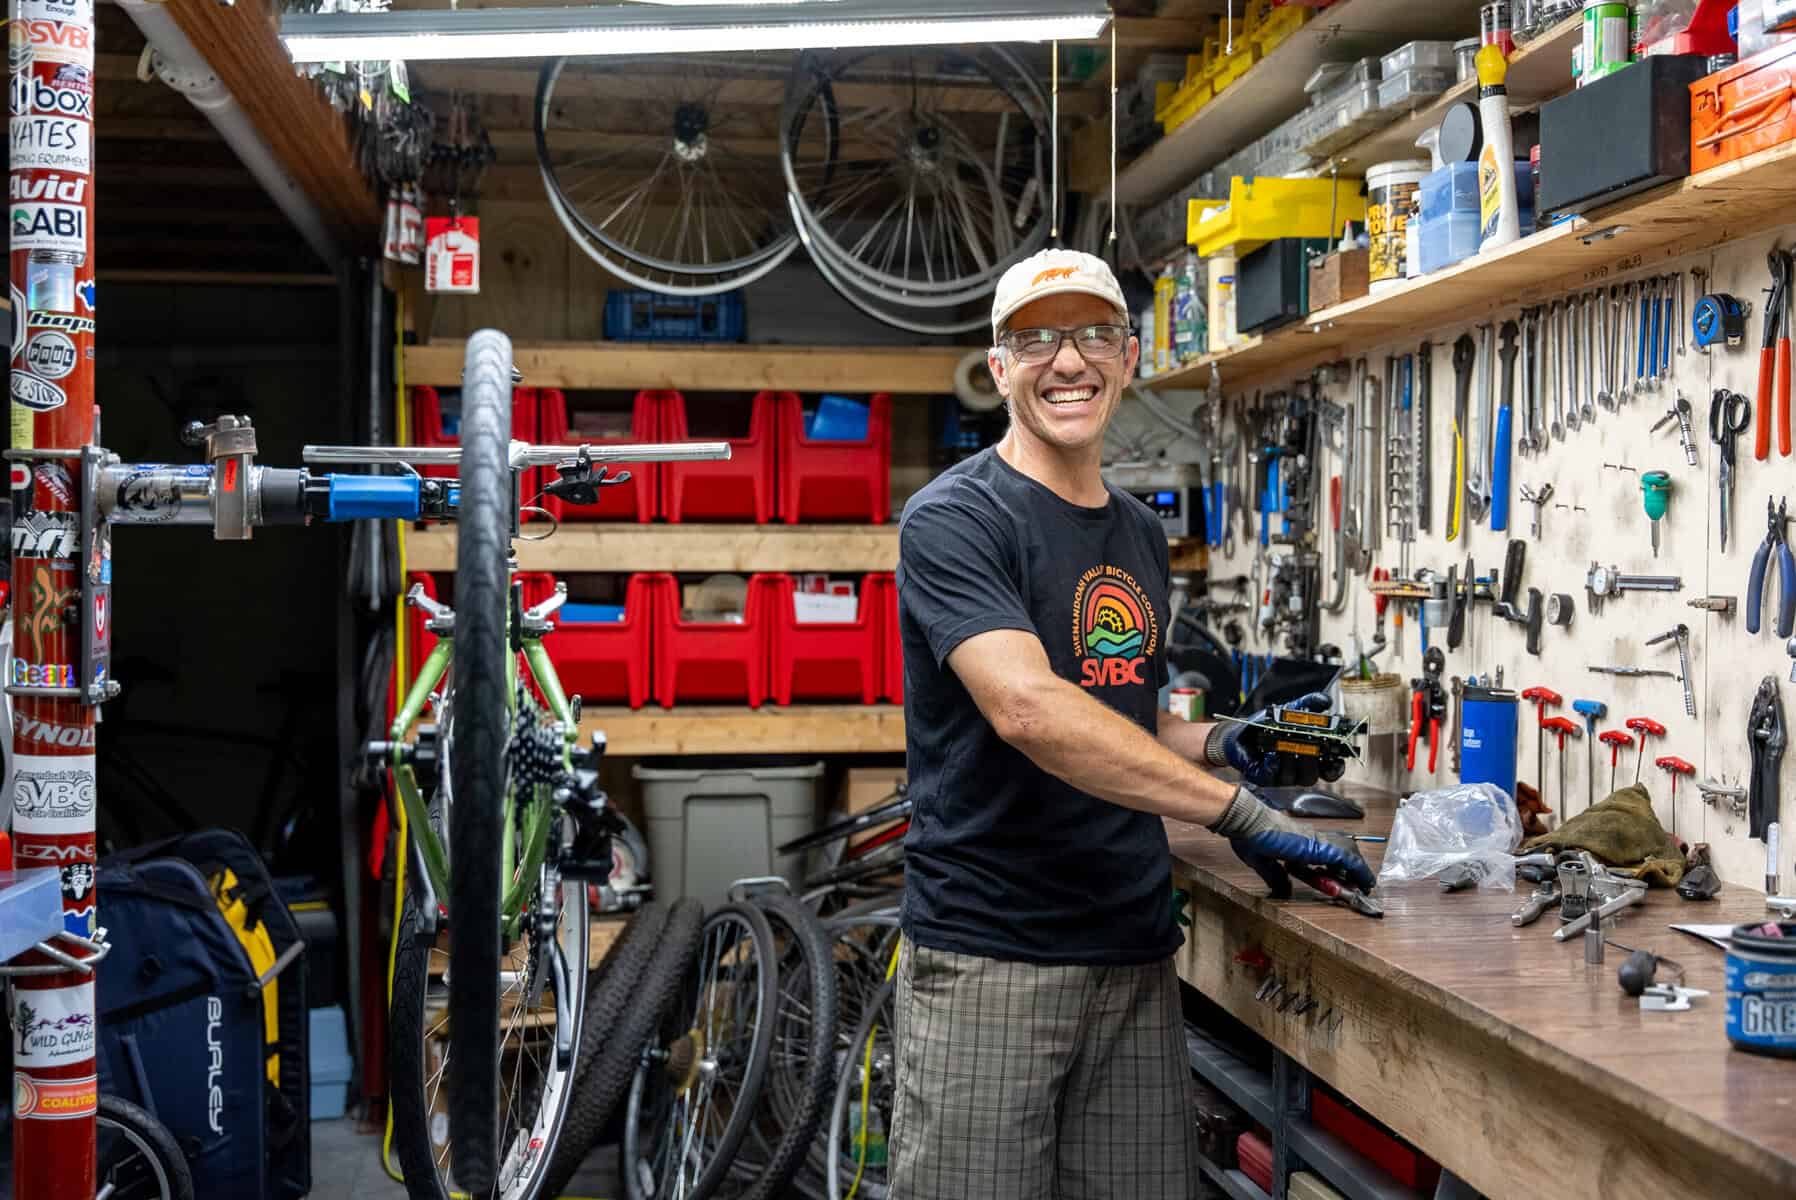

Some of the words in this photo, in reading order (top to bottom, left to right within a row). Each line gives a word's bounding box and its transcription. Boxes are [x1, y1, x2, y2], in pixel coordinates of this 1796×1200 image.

[10, 174, 88, 202] Avid
[1106, 566, 1142, 595] BICYCLE
[1141, 594, 1158, 656] COALITION
[1080, 657, 1146, 687] SVBC
[14, 779, 95, 812] SVBC
[31, 1033, 57, 1048] WILD
[207, 996, 223, 1136] BURLEY
